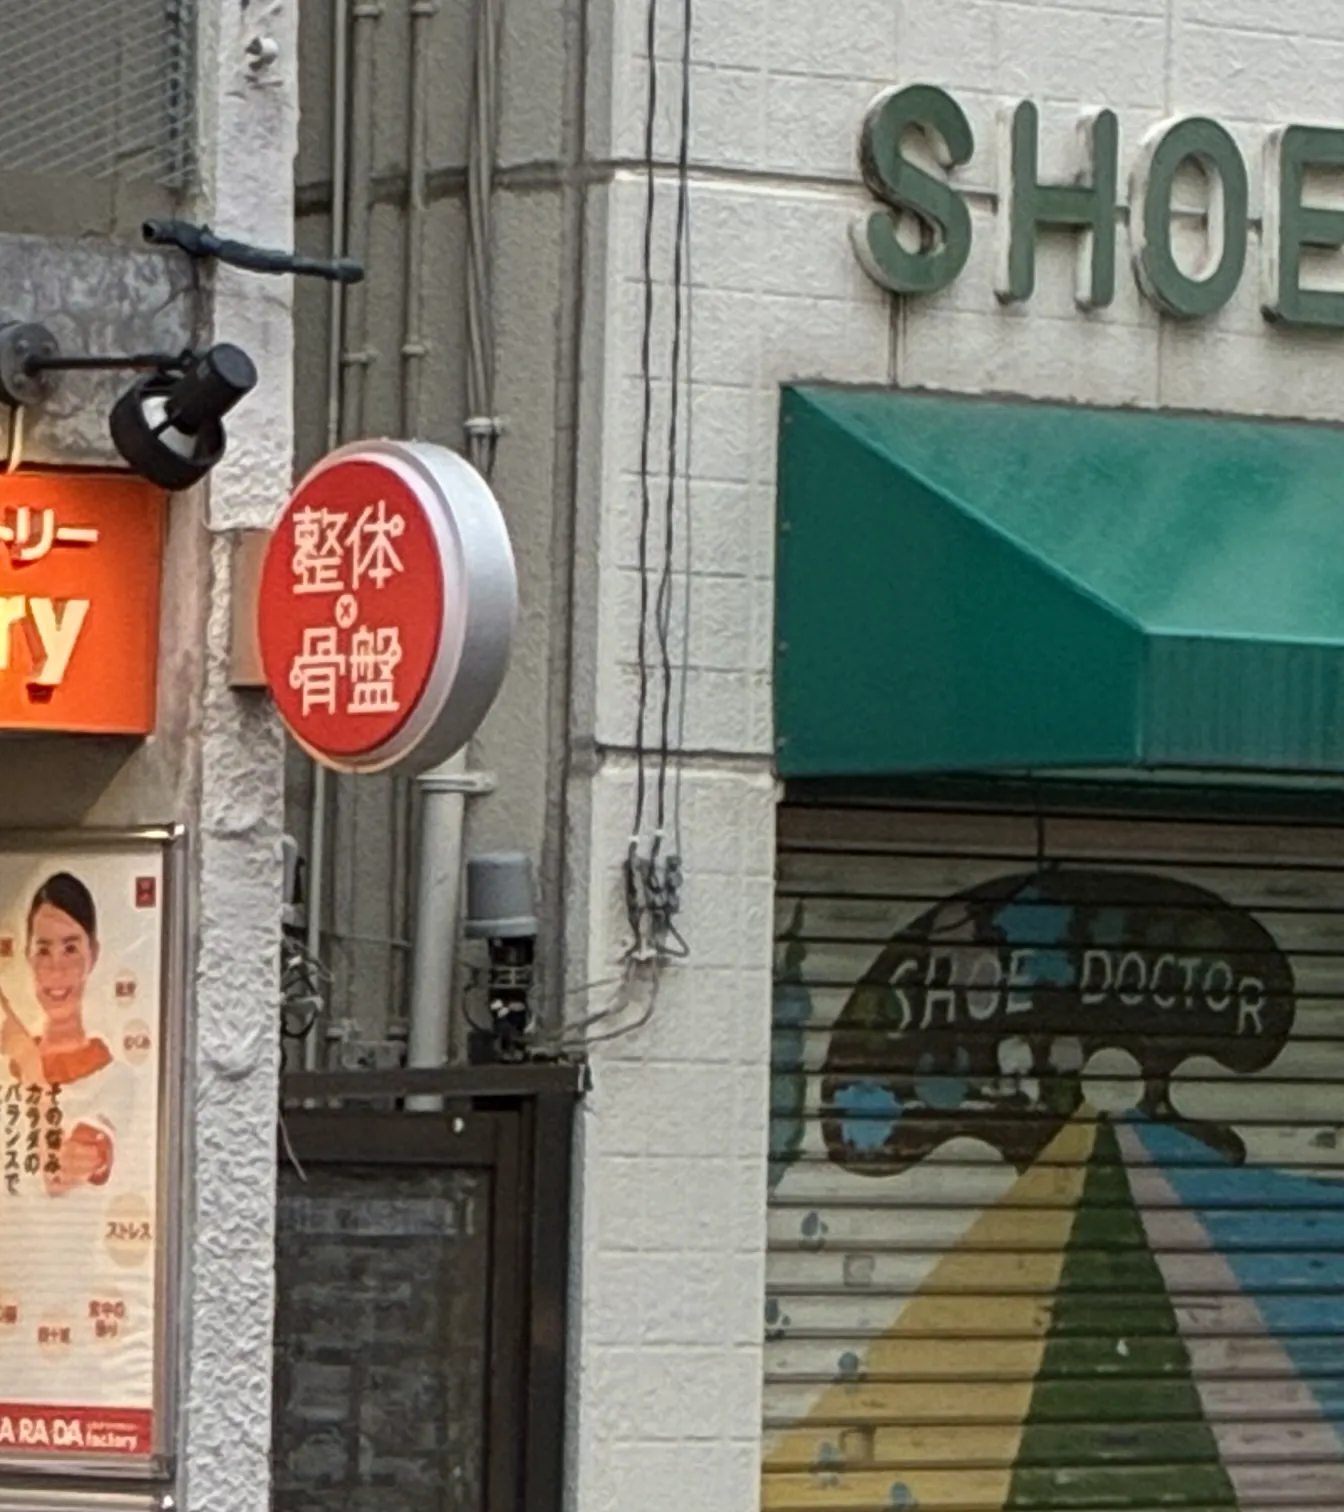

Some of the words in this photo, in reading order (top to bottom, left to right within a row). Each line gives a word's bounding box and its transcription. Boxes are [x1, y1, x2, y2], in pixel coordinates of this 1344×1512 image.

[289, 500, 405, 594] 整体
[289, 624, 403, 717] 骨盤
[887, 948, 1035, 1038] SHOE
[1079, 948, 1265, 1034] DOCTOR
[106, 1222, 151, 1239] ストレス
